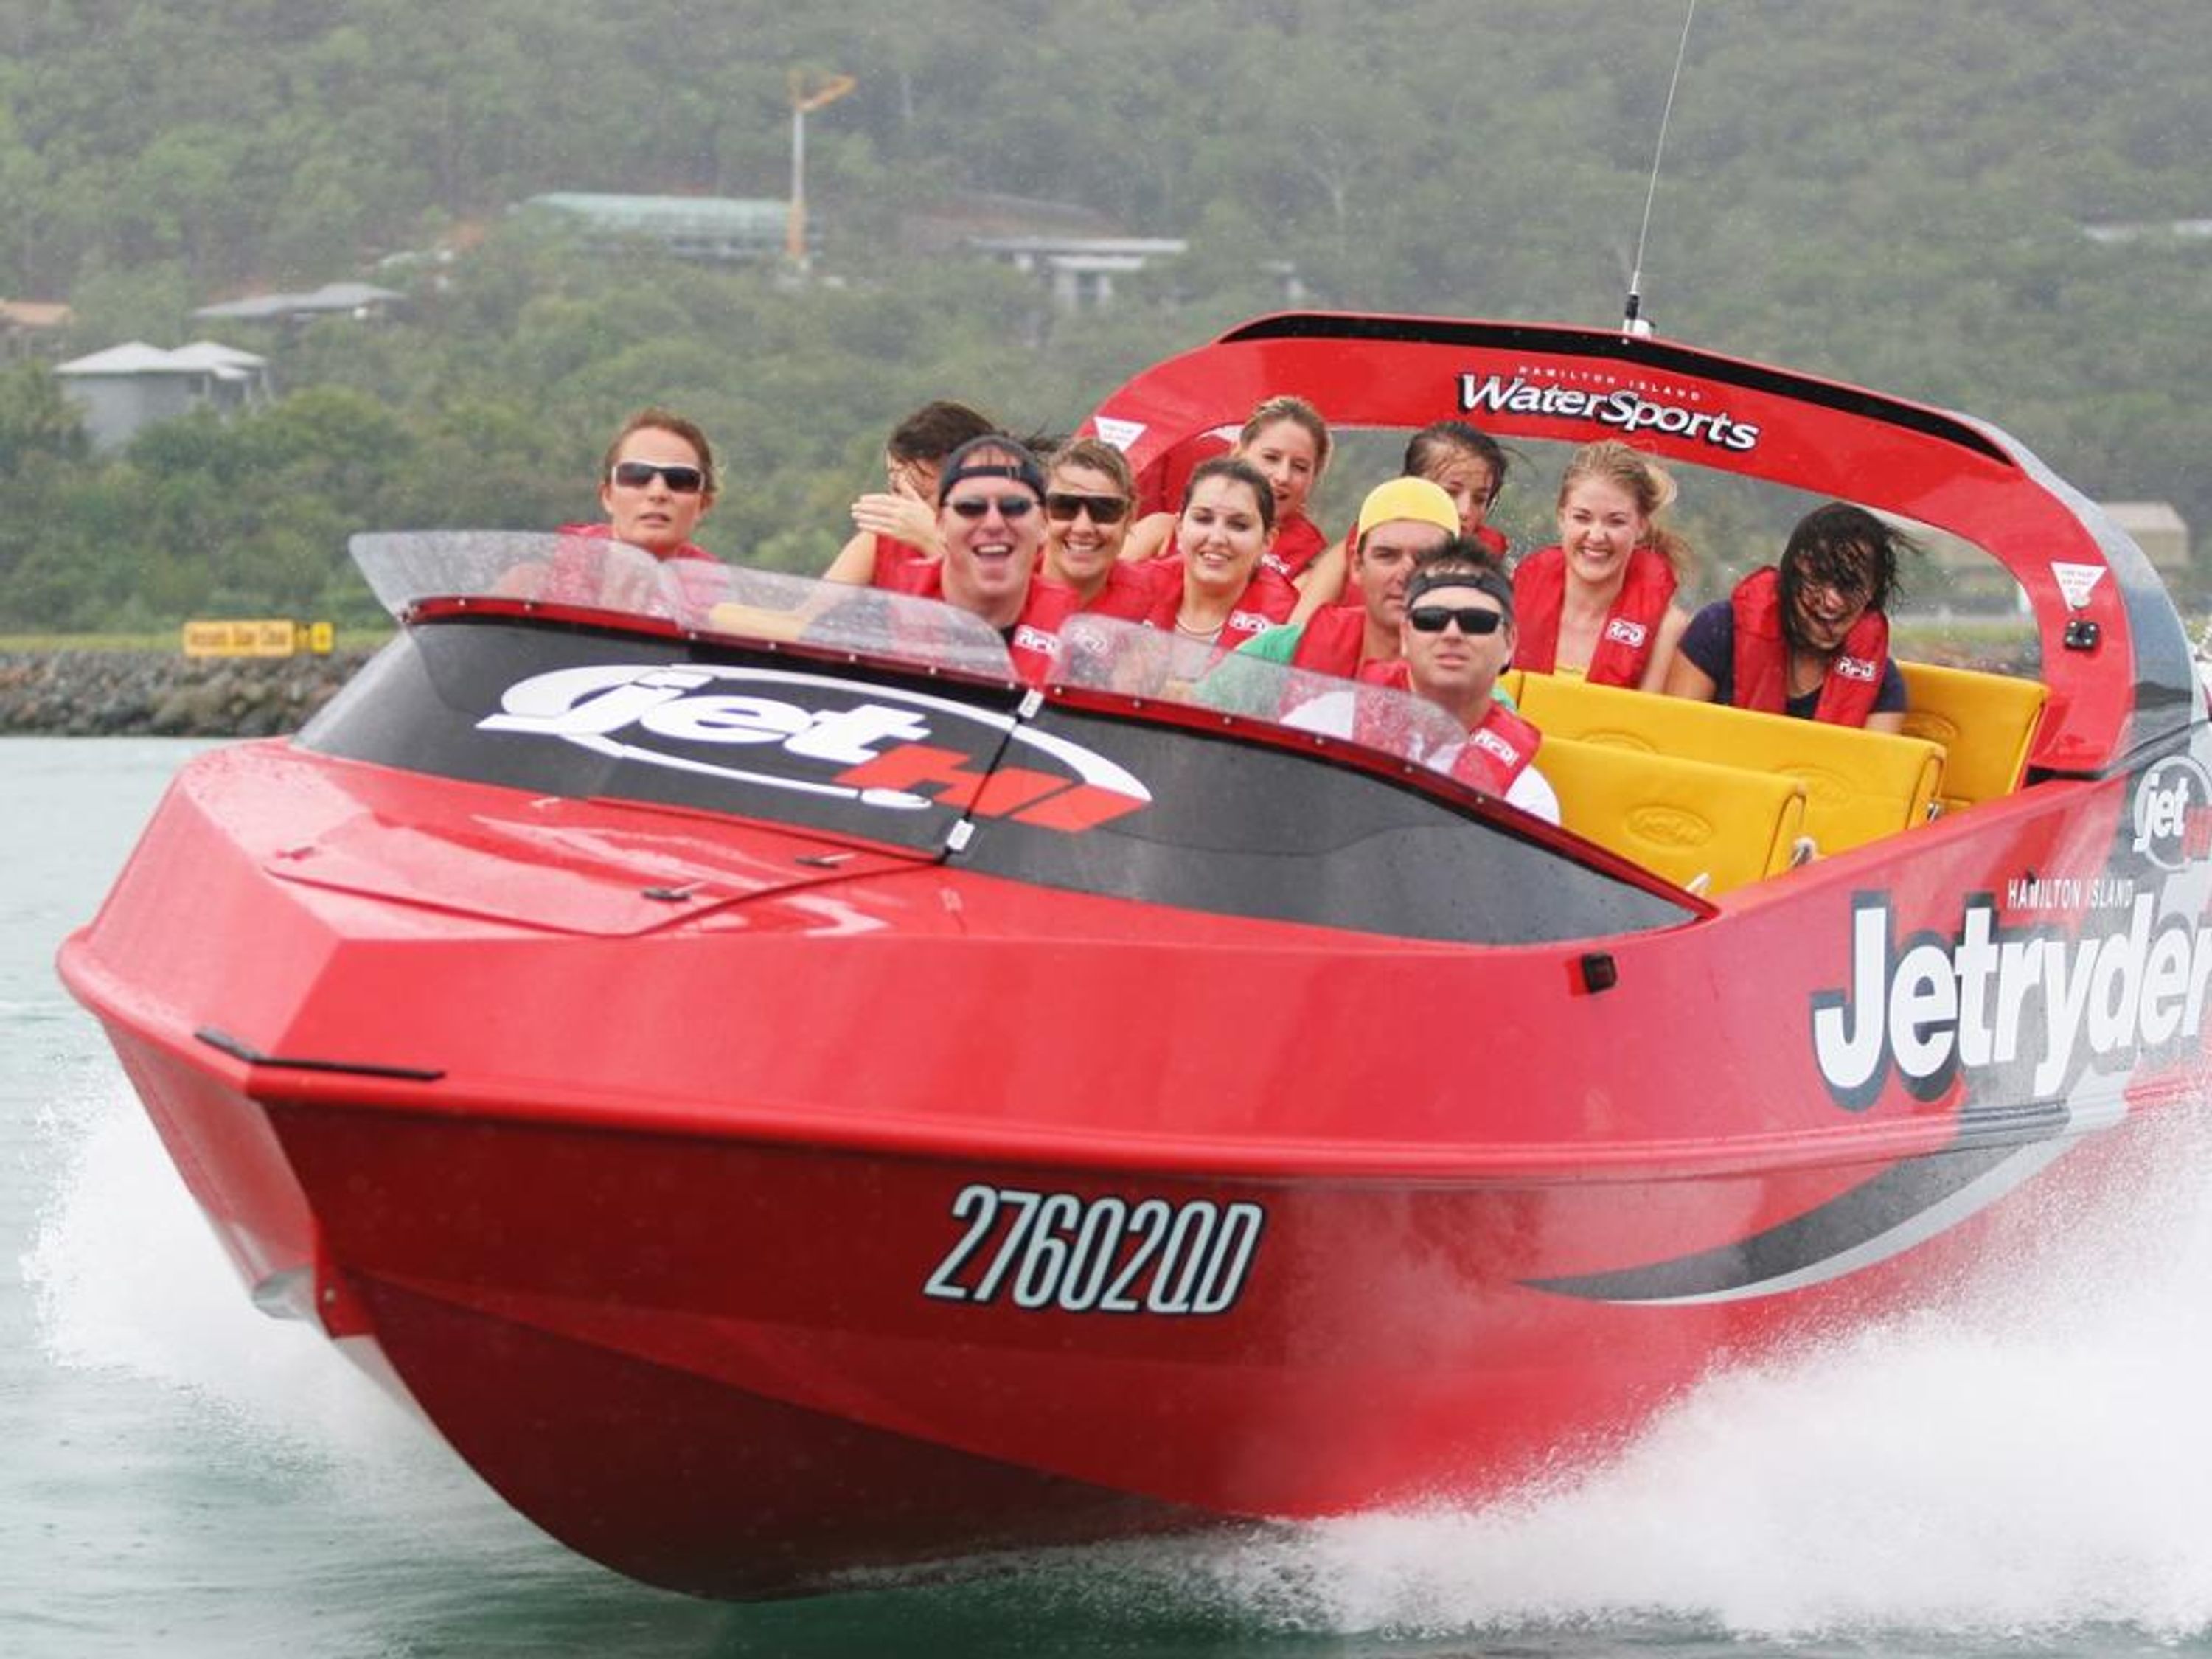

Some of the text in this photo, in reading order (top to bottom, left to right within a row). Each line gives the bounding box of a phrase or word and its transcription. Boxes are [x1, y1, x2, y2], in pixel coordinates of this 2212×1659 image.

[1461, 373, 1760, 451] WaterSports
[1519, 366, 1702, 402] HAMILTON ISLAND
[476, 669, 931, 764] jet
[2132, 773, 2188, 853] jet
[2006, 878, 2134, 909] HAMILTON ISLAND
[1814, 893, 2212, 1098] Jetryder
[923, 1183, 1263, 1313] 27602QD
